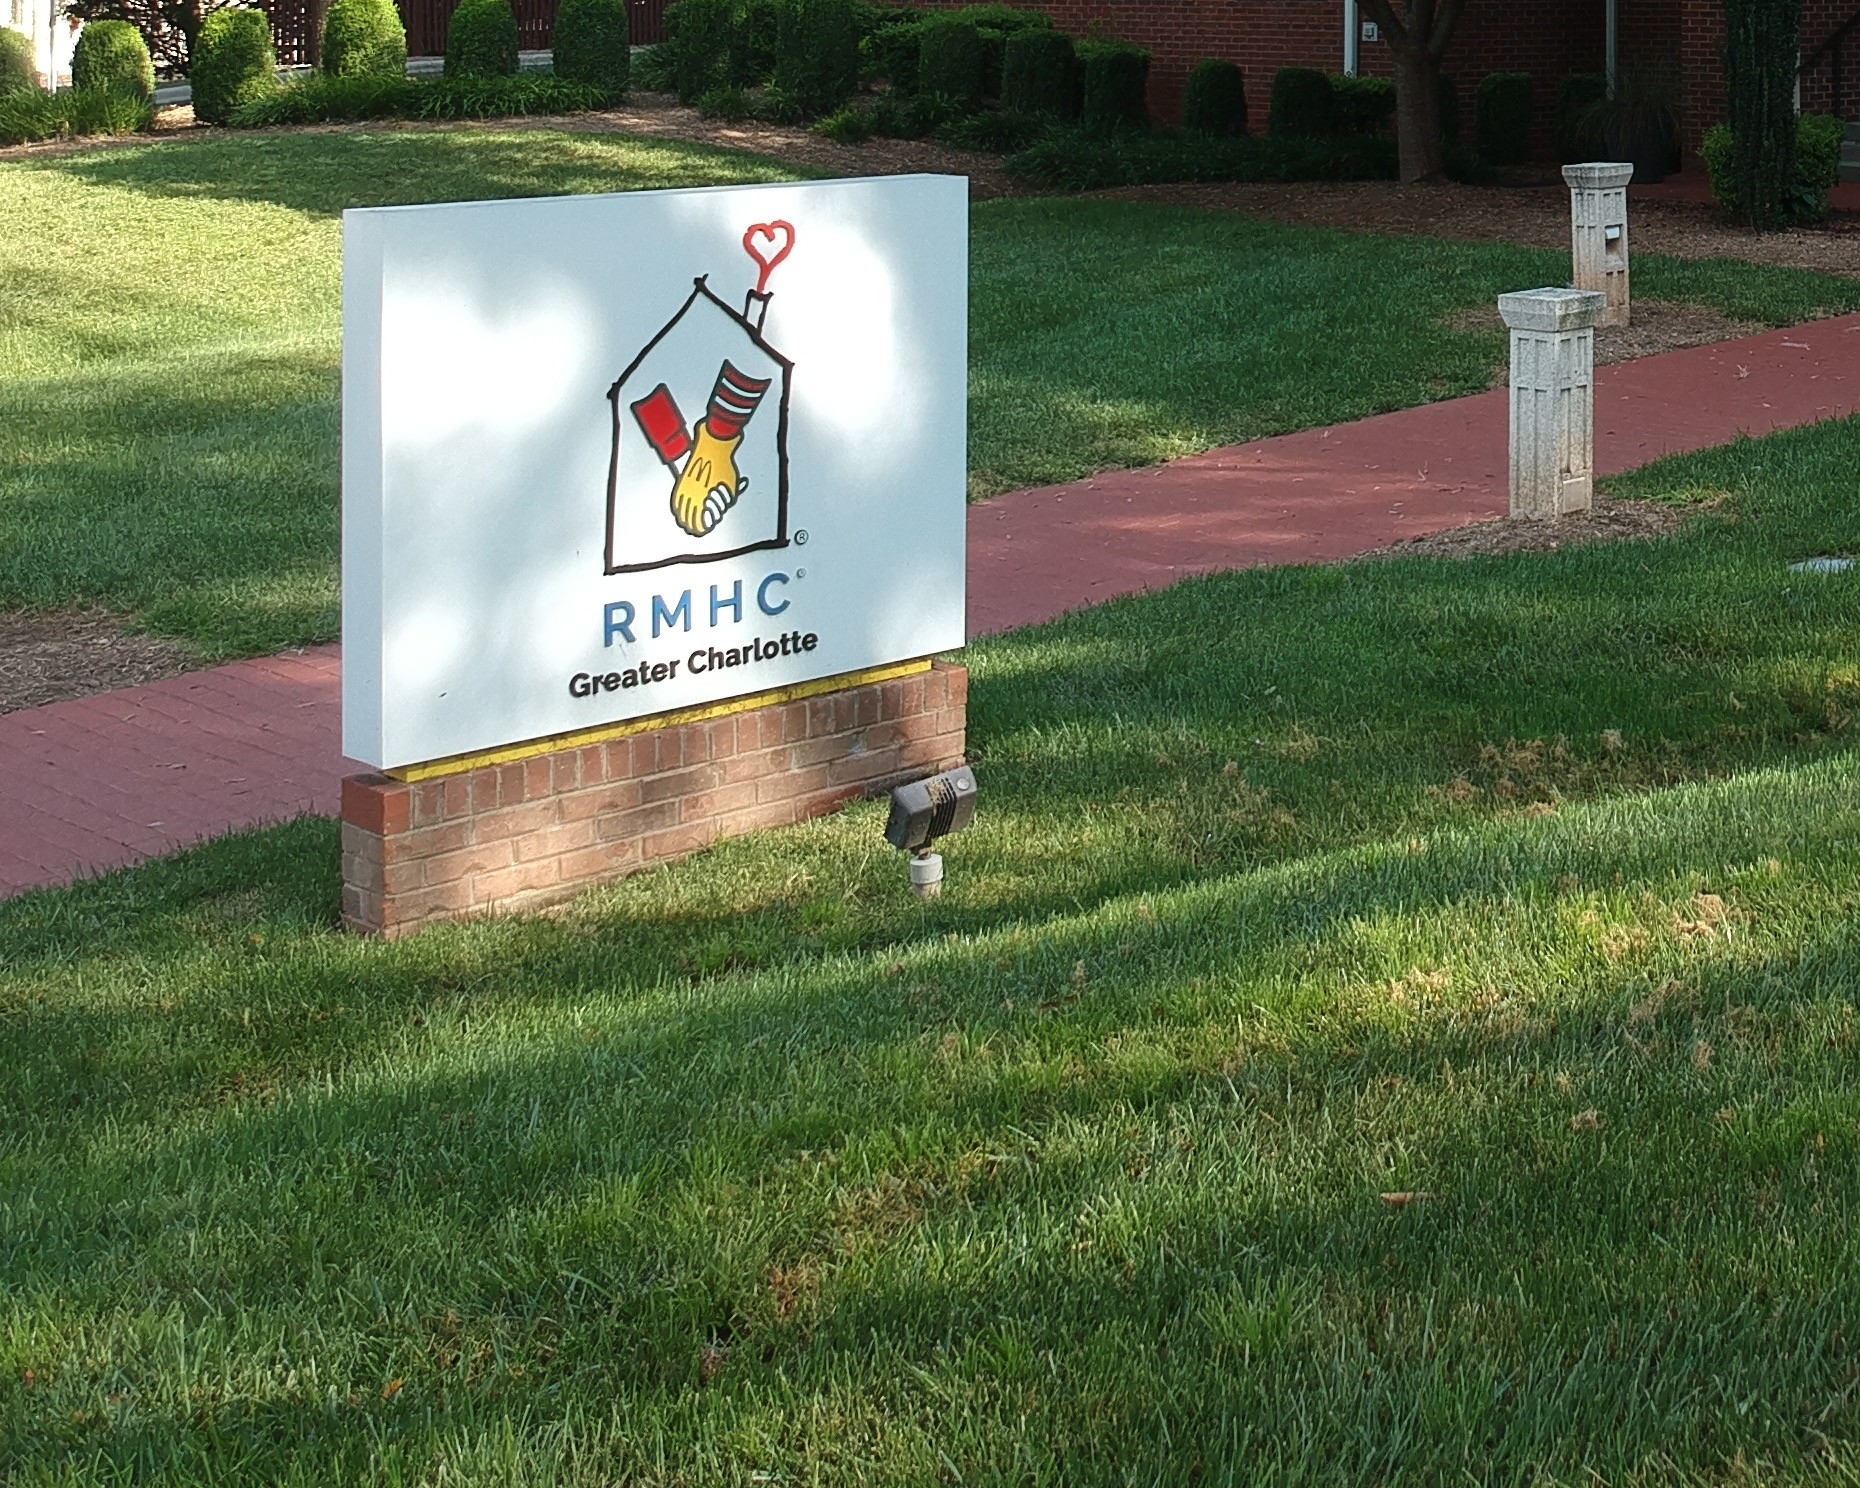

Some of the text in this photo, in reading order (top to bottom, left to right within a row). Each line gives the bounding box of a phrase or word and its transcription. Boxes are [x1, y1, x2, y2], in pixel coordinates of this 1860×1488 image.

[604, 572, 790, 647] RMHC
[569, 630, 818, 698] Greater Charlotte
